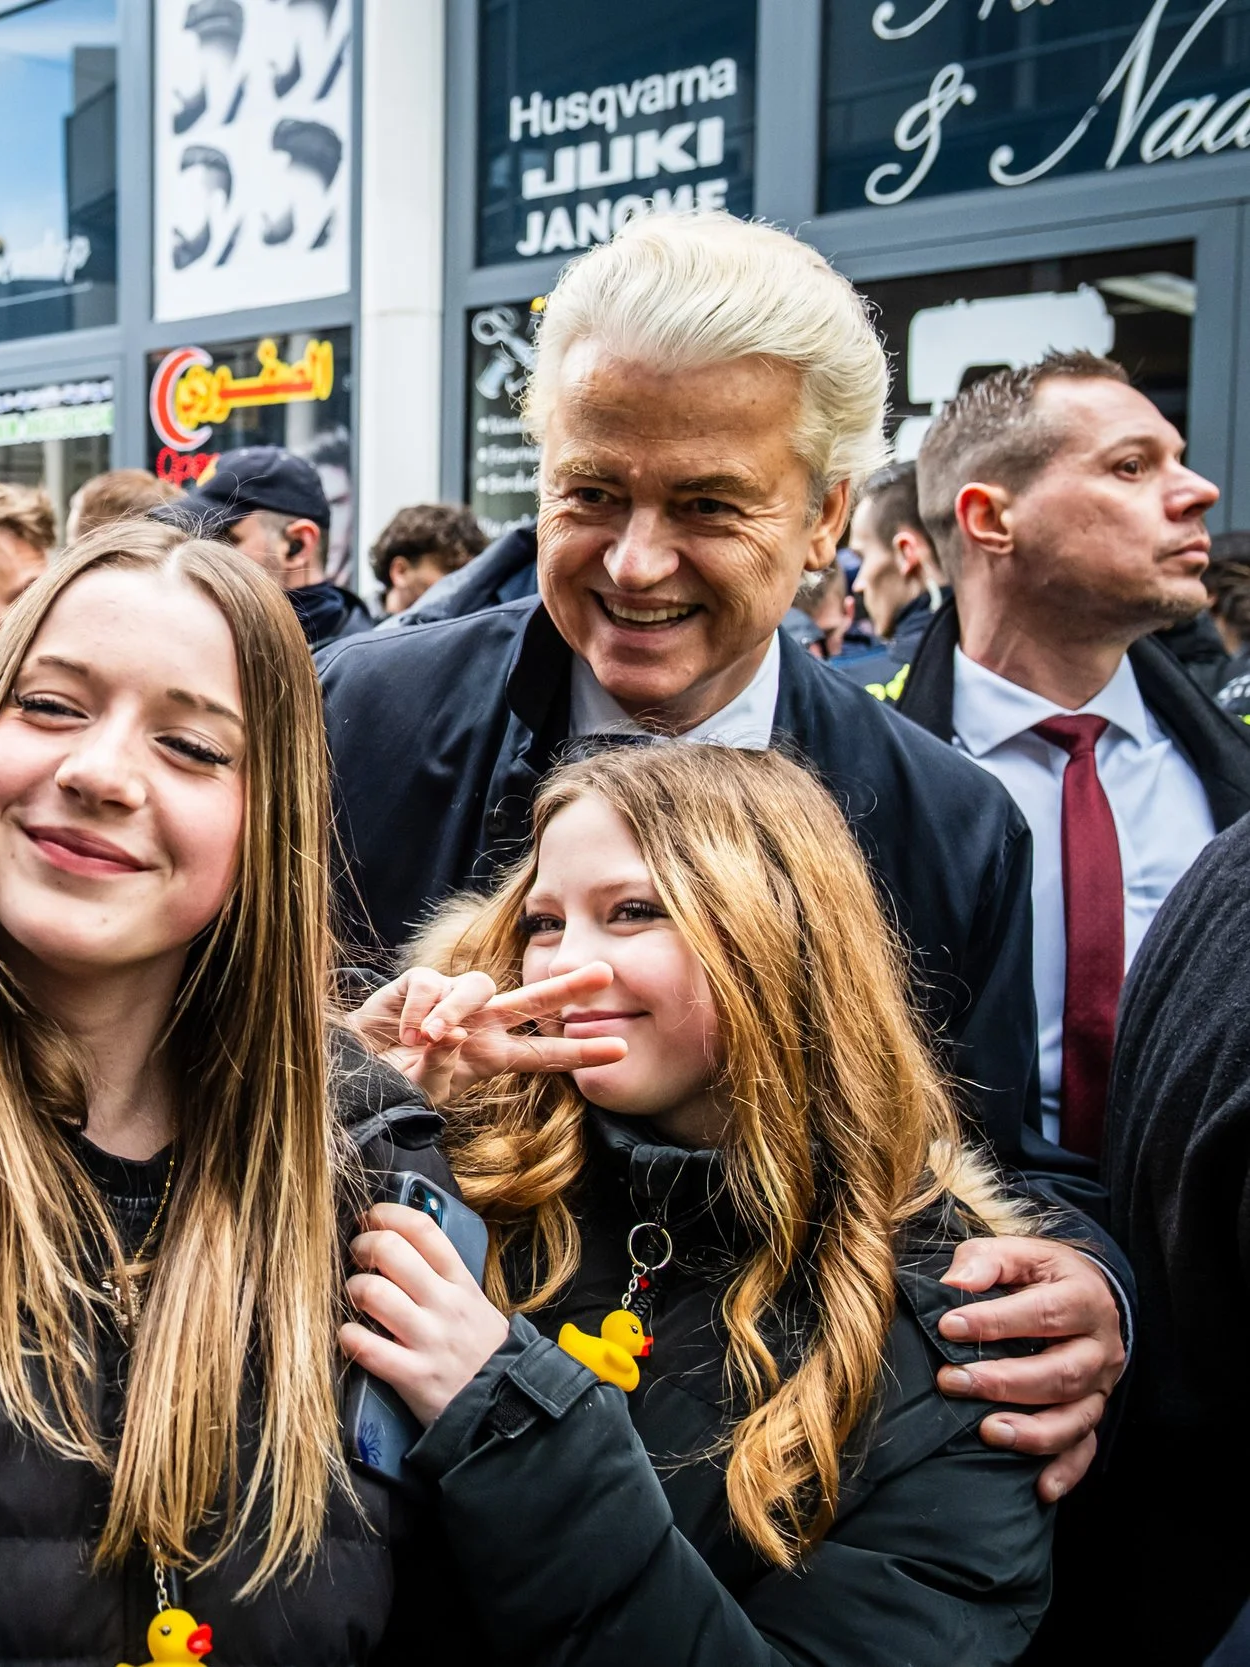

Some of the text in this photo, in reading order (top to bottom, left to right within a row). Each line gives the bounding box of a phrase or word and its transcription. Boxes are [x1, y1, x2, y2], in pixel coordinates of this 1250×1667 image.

[509, 57, 737, 142] Husqvarna
[864, 63, 977, 205] &
[521, 116, 725, 200] JUKI
